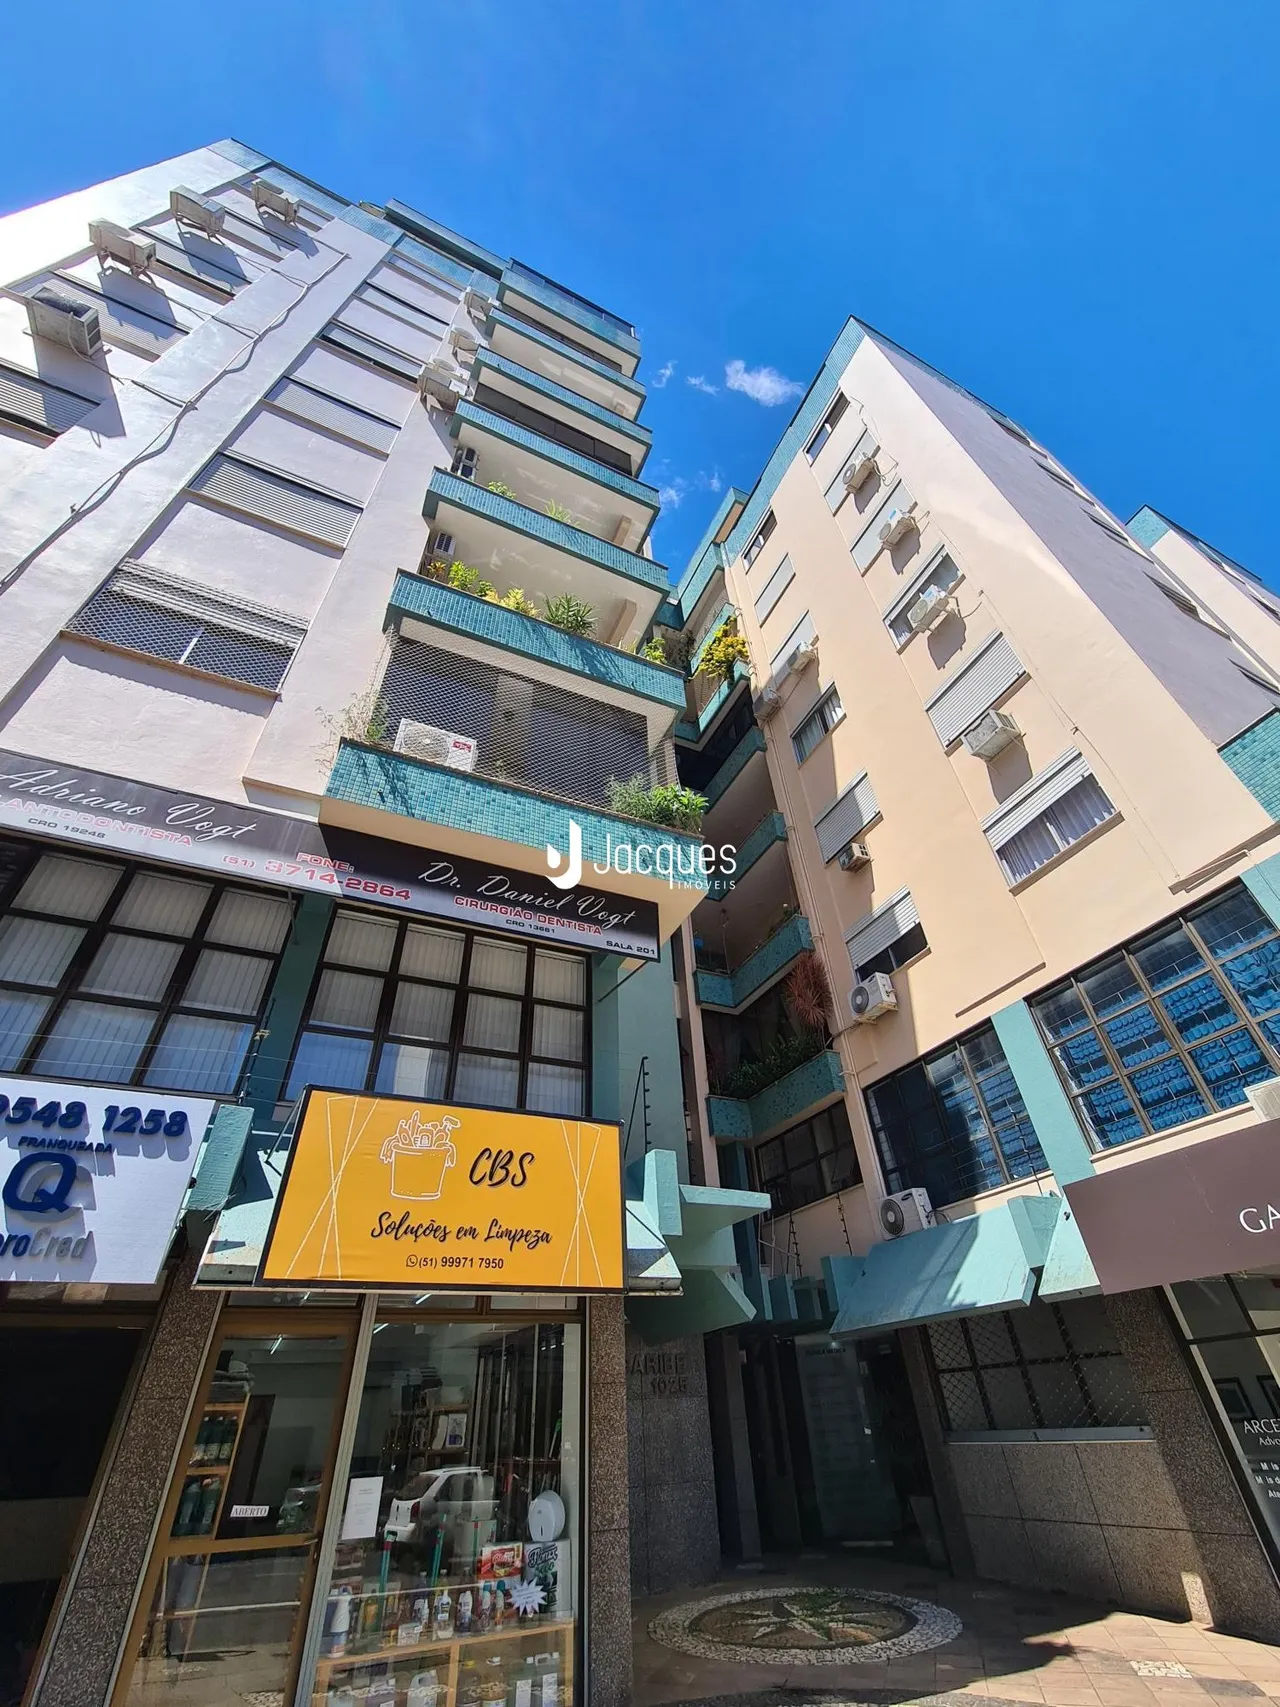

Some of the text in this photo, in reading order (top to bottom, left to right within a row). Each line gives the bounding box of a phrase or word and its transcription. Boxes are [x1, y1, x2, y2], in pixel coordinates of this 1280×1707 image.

[0, 797, 192, 847] ANTODONTISTA
[165, 803, 257, 842] Vogt
[264, 858, 412, 902] 3714-2864
[295, 852, 355, 874] FONE:
[418, 862, 636, 930] Dr. Daniel Vogt
[454, 895, 603, 936] CIRURGIÃO DENTISTA
[606, 940, 655, 955] SALA 201
[102, 1105, 188, 1136] 1258
[18, 1136, 113, 1152] FRANQUEADA
[2, 1152, 77, 1213] Q
[468, 1147, 535, 1187] CBS
[371, 1211, 553, 1252] Soluções em Limpeza
[418, 1256, 504, 1269] (51) 99971 7950
[625, 1352, 687, 1375] ARIBE
[231, 1506, 268, 1516] ABERTO
